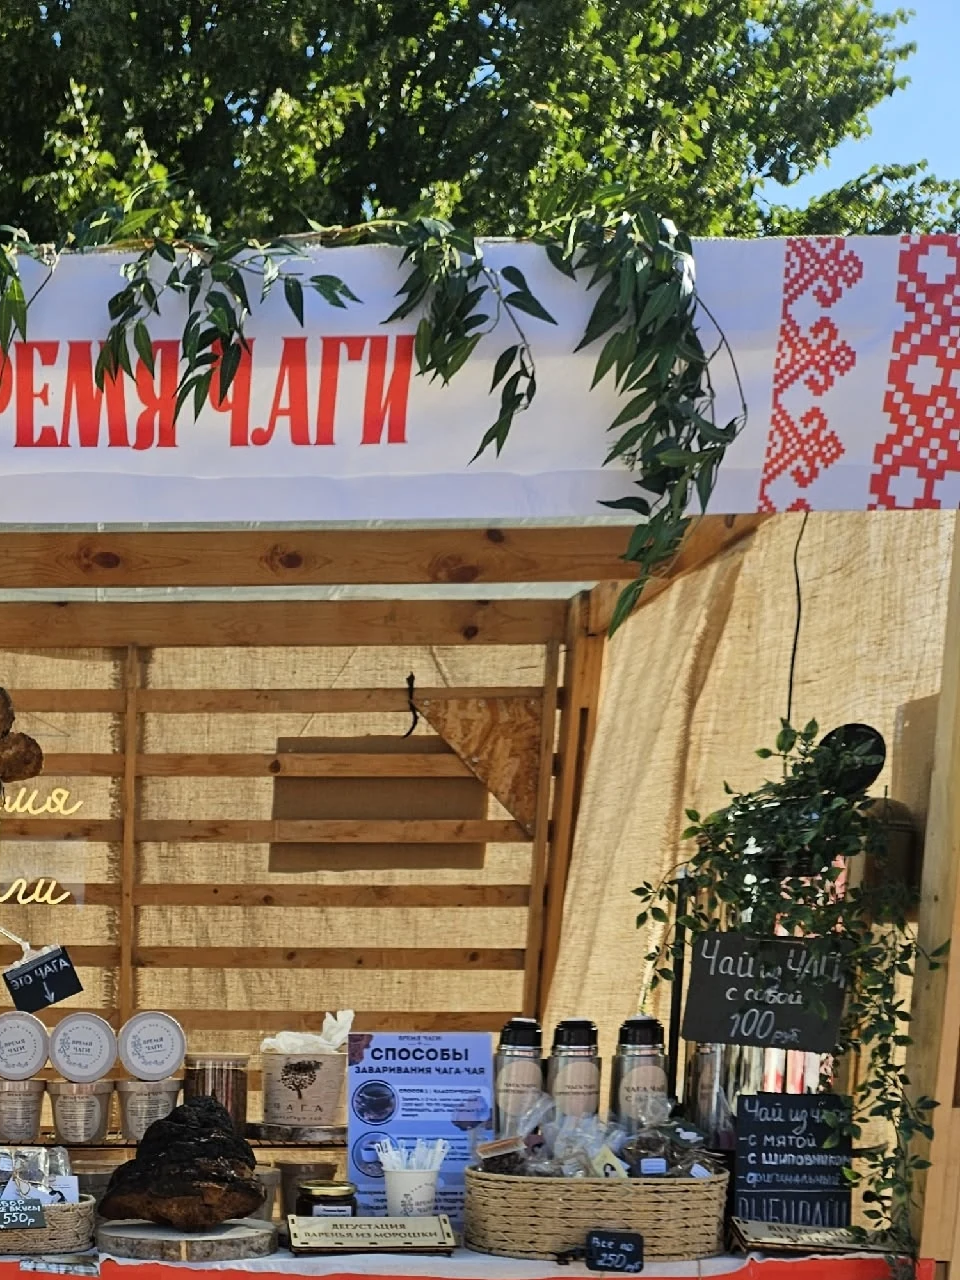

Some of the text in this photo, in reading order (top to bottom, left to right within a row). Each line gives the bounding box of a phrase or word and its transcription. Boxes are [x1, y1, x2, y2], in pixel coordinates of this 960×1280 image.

[207, 335, 415, 448] ЧАГИ
[701, 939, 754, 978] Чай
[10, 958, 70, 990] ЭТО ЧАГА
[725, 987, 803, 1005] с собой
[730, 1008, 775, 1039] 100
[371, 1047, 469, 1061] СПОСОБЫ
[355, 1066, 485, 1075] ЗАВАРИВАНИЯ ЧАГА-ЧАЯ
[273, 1102, 323, 1112] ЧАГА
[744, 1099, 785, 1122] Чай
[790, 1108, 808, 1135] из
[764, 1133, 817, 1149] мятой
[373, 1231, 438, 1239] МОРОШКИ
